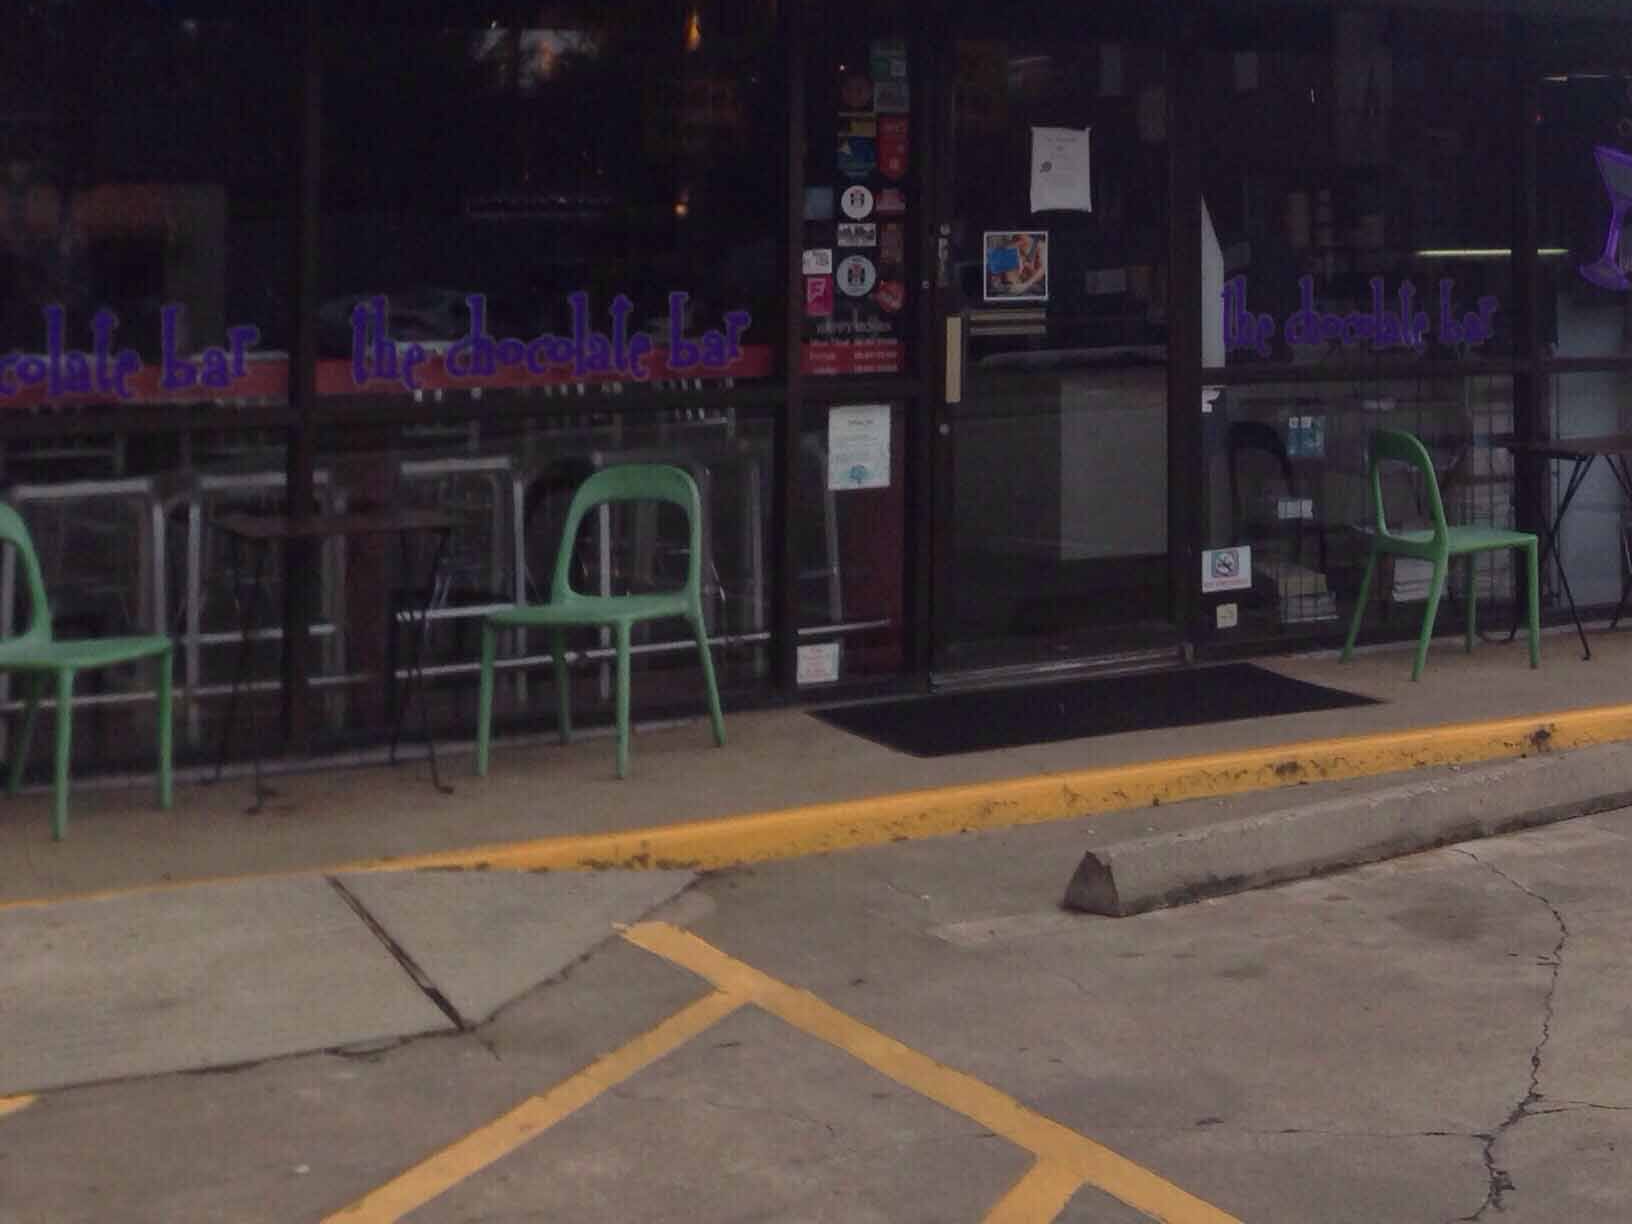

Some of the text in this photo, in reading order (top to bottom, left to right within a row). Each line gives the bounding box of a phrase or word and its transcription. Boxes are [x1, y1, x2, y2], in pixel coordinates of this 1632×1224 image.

[161, 304, 261, 390] bar
[351, 294, 426, 389] the
[446, 291, 653, 378] chocolate
[668, 291, 751, 368] bar
[1221, 274, 1498, 355] the chocolate bar
